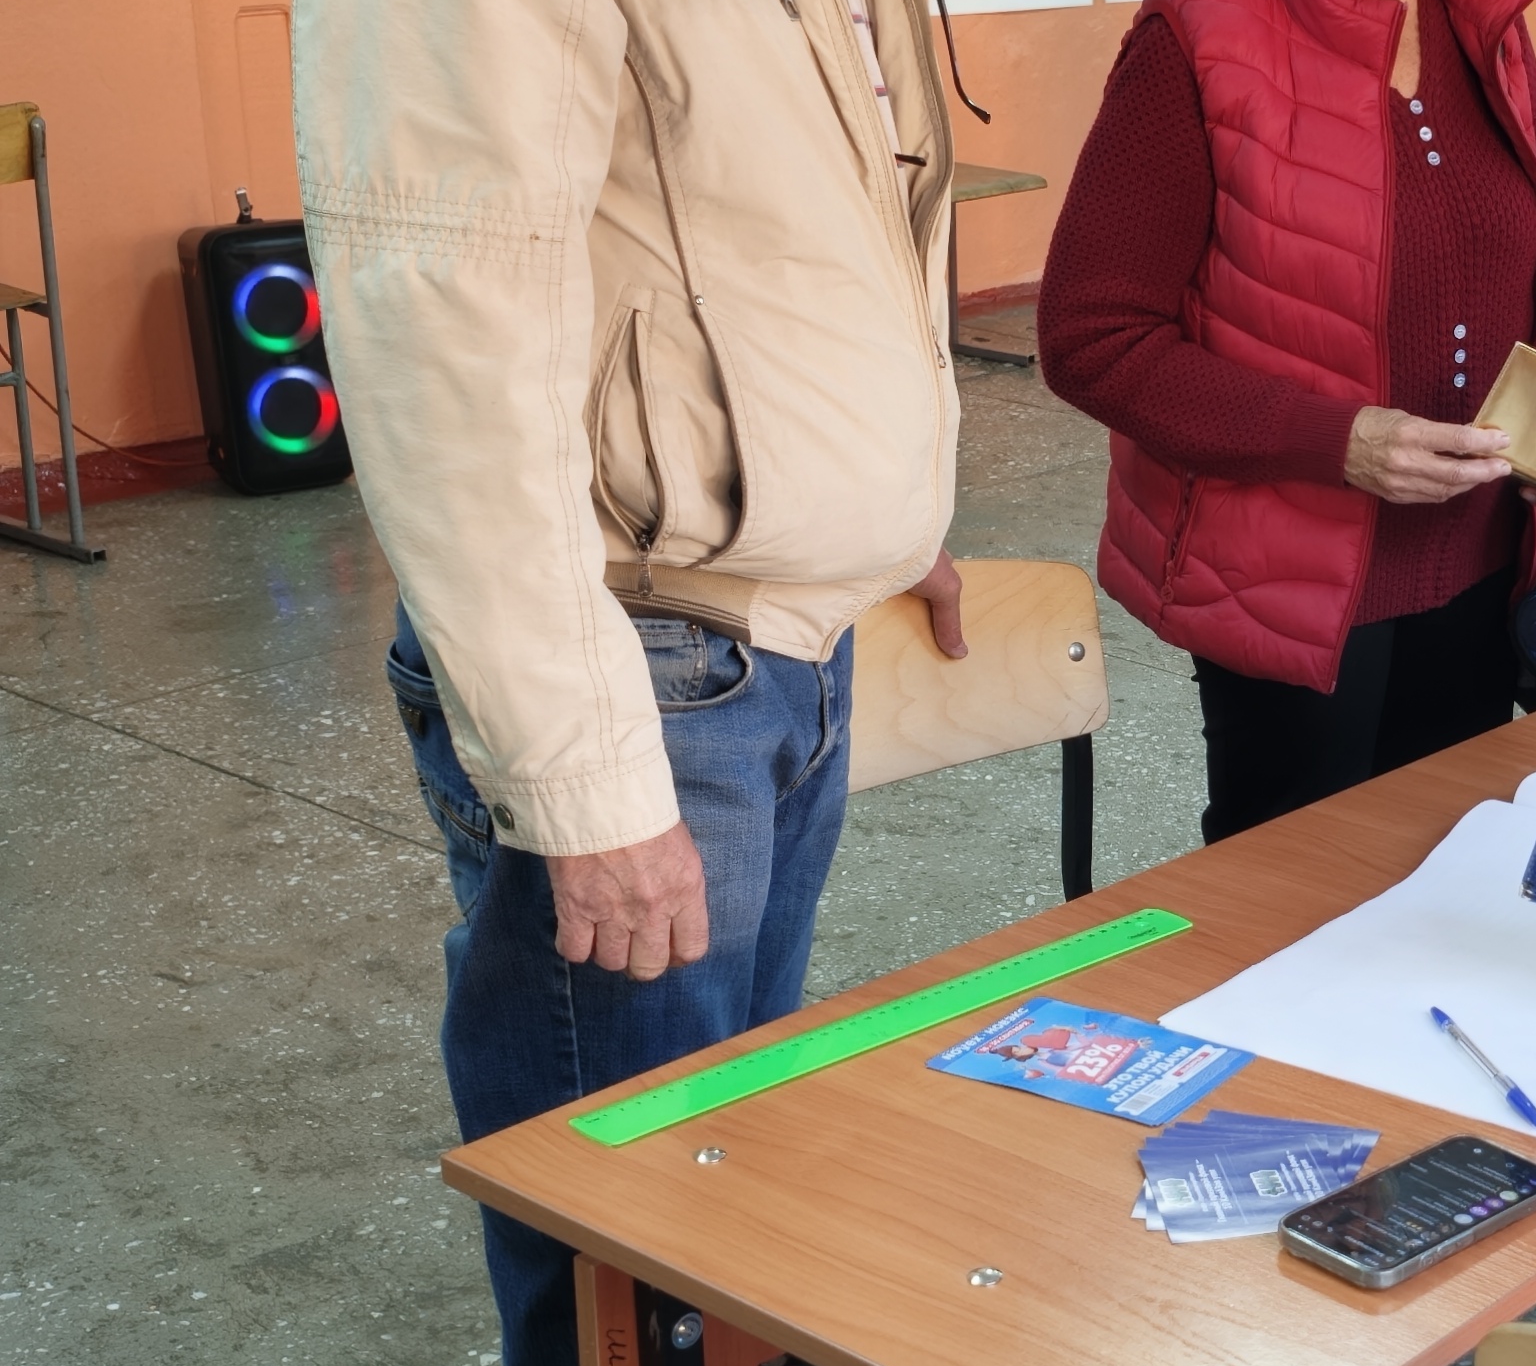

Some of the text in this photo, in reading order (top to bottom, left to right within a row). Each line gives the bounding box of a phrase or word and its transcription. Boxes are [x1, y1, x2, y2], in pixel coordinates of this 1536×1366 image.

[1066, 1043, 1123, 1077] 23%
[1103, 1071, 1133, 1091] ЭТО
[1131, 1049, 1166, 1074] ТВОЙ
[1106, 1071, 1156, 1104] КУПОН
[1150, 1046, 1194, 1076] УДАЧИ
